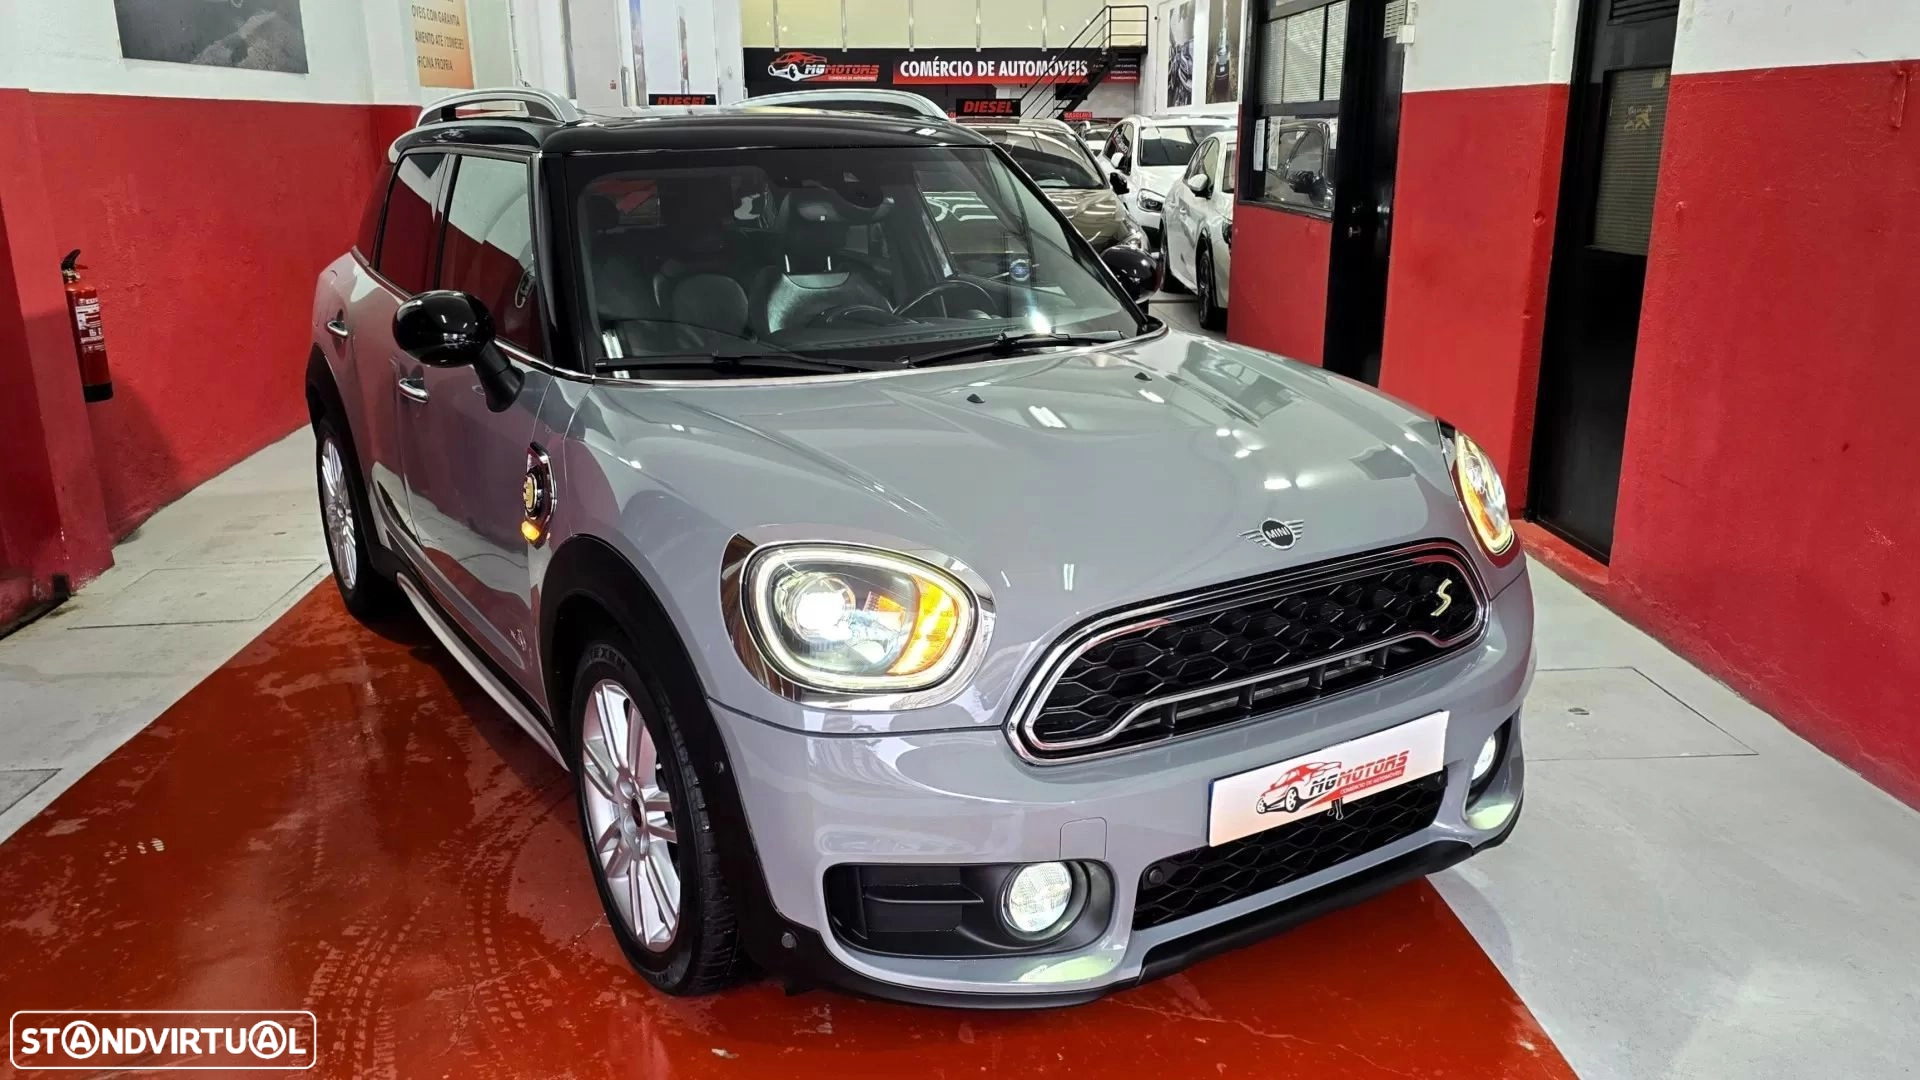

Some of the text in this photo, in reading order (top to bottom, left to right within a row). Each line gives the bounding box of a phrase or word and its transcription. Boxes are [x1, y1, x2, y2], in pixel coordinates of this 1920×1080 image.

[900, 56, 1088, 77] COMÉRCIO DE AUTOMÓVEIS
[963, 101, 1013, 113] DIESEL
[1265, 526, 1291, 539] MINI
[1430, 578, 1452, 617] S
[1308, 750, 1410, 797] MGMOTORS
